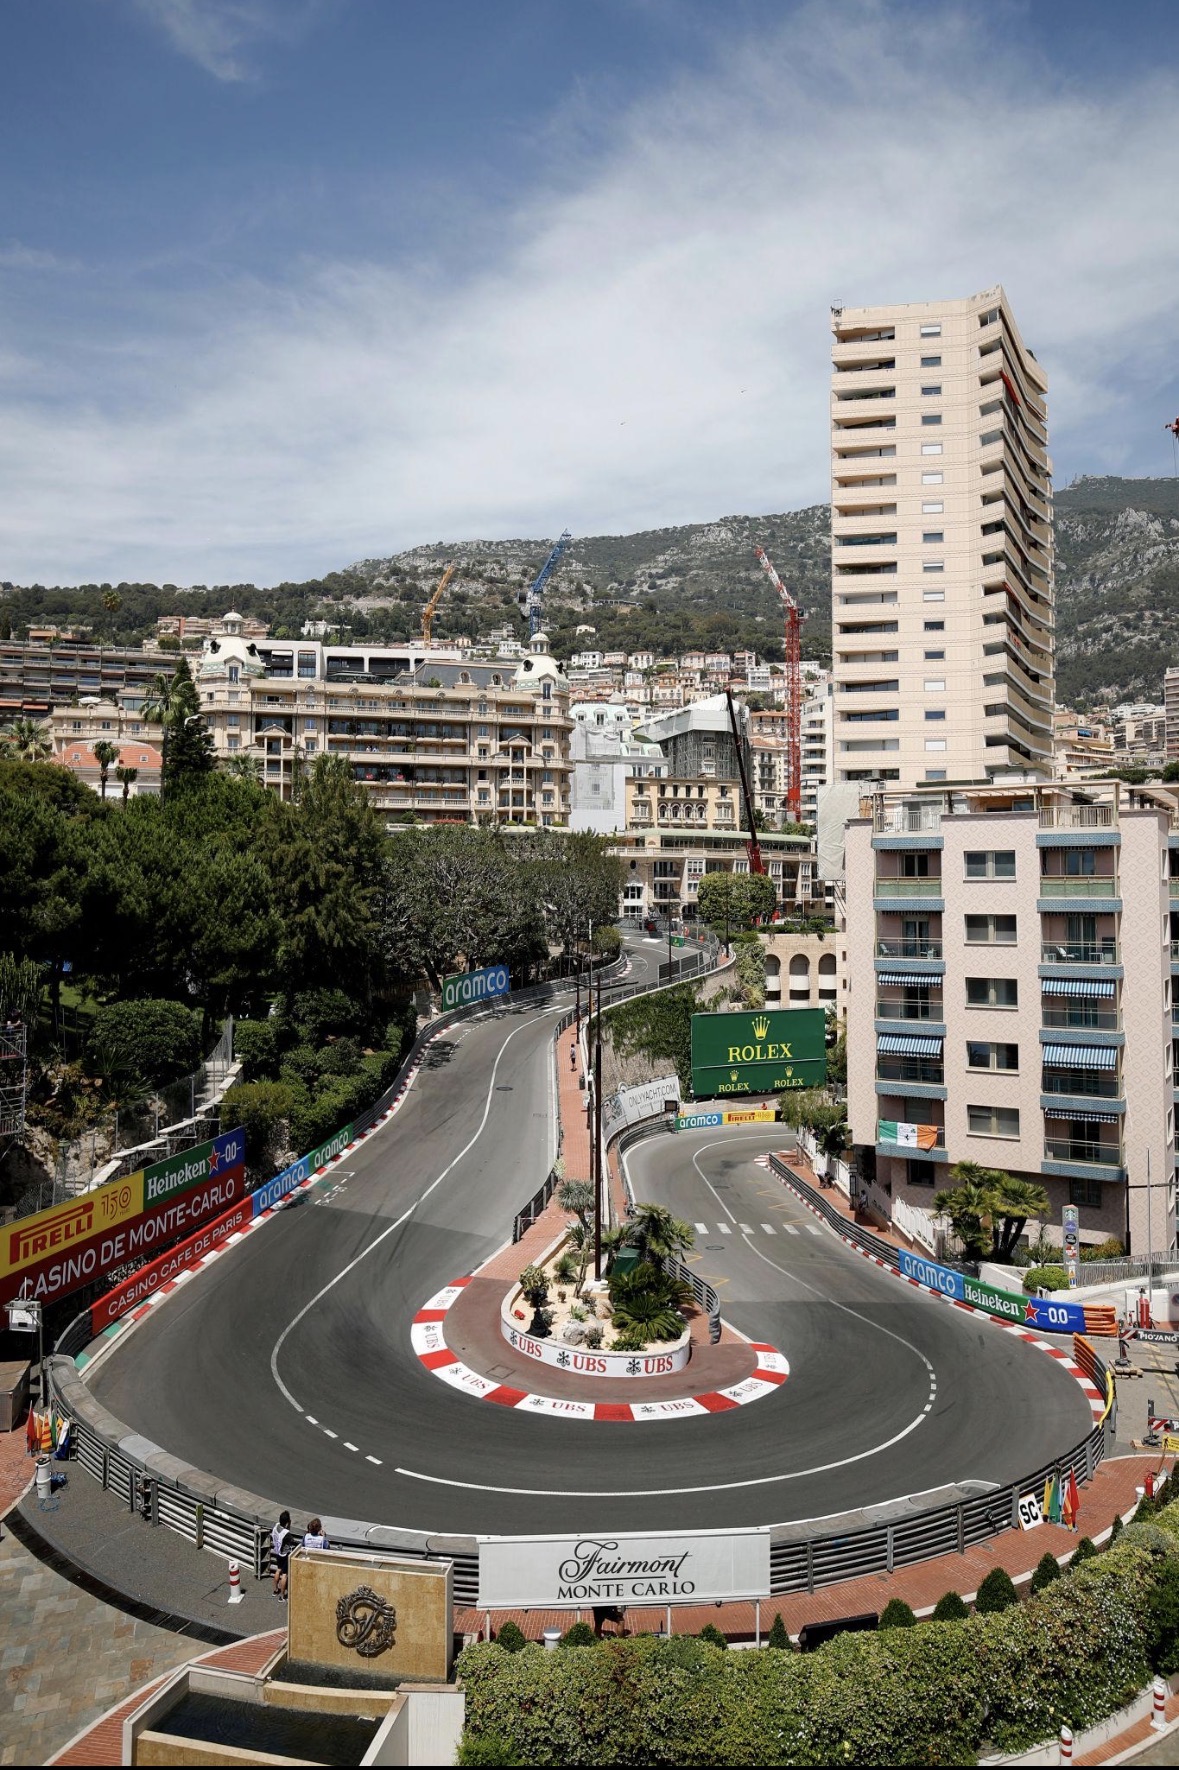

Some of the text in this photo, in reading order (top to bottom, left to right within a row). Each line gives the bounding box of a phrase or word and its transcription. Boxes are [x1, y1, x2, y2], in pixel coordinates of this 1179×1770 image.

[446, 970, 506, 1005] aramco
[728, 1043, 792, 1062] ROLEX
[718, 1082, 749, 1092] ROLEX
[774, 1078, 803, 1088] ROLEX
[679, 1114, 718, 1128] aramco
[727, 1112, 755, 1122] PIRELLI
[314, 1131, 349, 1168] aramco
[147, 1159, 206, 1200] Heineken
[260, 1165, 305, 1208] aramco
[9, 1201, 94, 1265] PIRELLI
[101, 1233, 126, 1266] DE
[129, 1178, 235, 1251] MONTE-CARLO
[108, 1211, 243, 1316] CASINO CAFE DE PARIS
[904, 1256, 956, 1295] aramco
[964, 1284, 1020, 1317] Heineken
[518, 1336, 542, 1358] UBS
[573, 1355, 607, 1373] UBS
[644, 1355, 673, 1374] UBS
[462, 1374, 489, 1389] UBS
[551, 1402, 586, 1412] UBS
[660, 1401, 694, 1412] UBS
[1020, 1500, 1039, 1524] SC
[558, 1540, 692, 1583] Fairmont
[557, 1580, 695, 1600] MONTE CARLO
